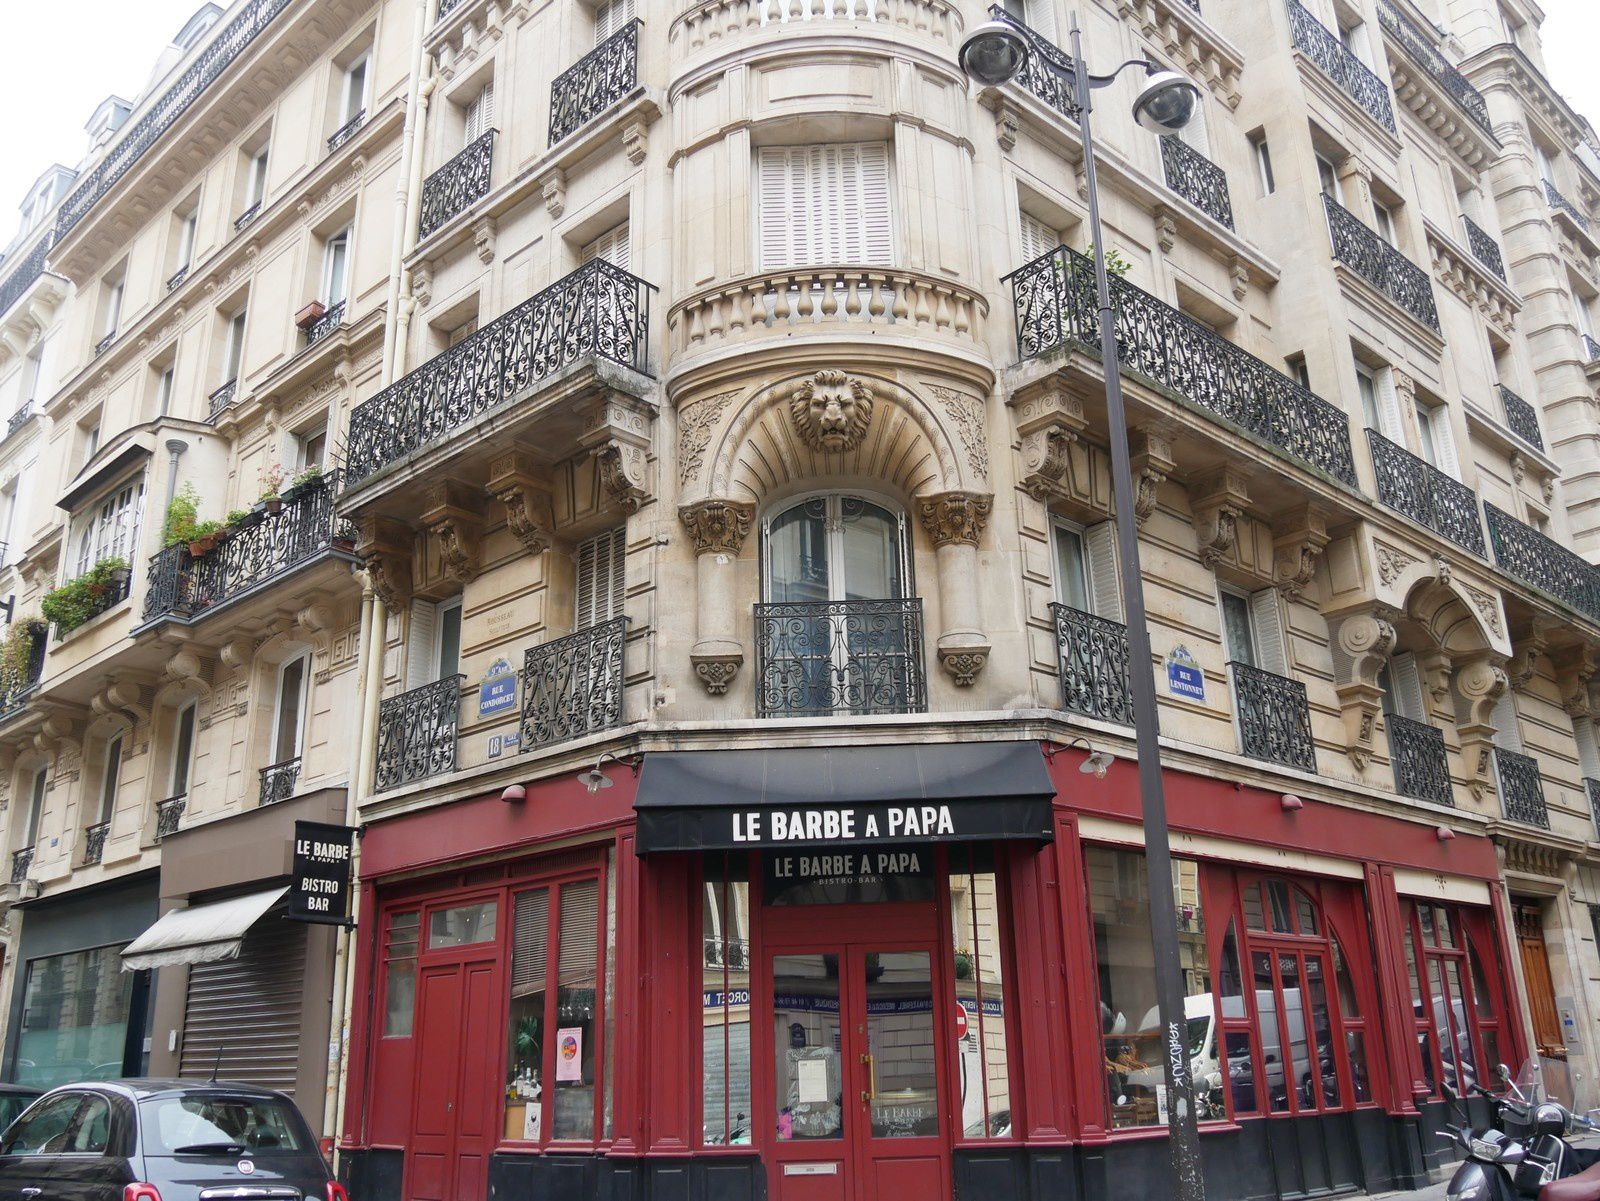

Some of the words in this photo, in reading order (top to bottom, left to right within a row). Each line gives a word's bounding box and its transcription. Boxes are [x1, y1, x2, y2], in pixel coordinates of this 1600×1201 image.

[1179, 671, 1191, 681] RUE
[491, 684, 504, 695] RUE
[480, 693, 515, 709] CONDORCET
[490, 737, 500, 756] 18
[732, 812, 761, 842] LE
[771, 809, 856, 841] BARBE
[865, 814, 879, 838] A
[887, 805, 955, 837] PAPA
[296, 839, 311, 855] LE
[313, 841, 349, 860] BARBE
[775, 857, 793, 877] LE
[799, 855, 853, 876] BARBE
[860, 854, 871, 874] A
[878, 853, 920, 874] PAPA
[301, 877, 339, 894] BISTRO
[819, 877, 853, 885] BISTRO
[858, 876, 877, 884] BAR
[307, 896, 329, 911] BAR
